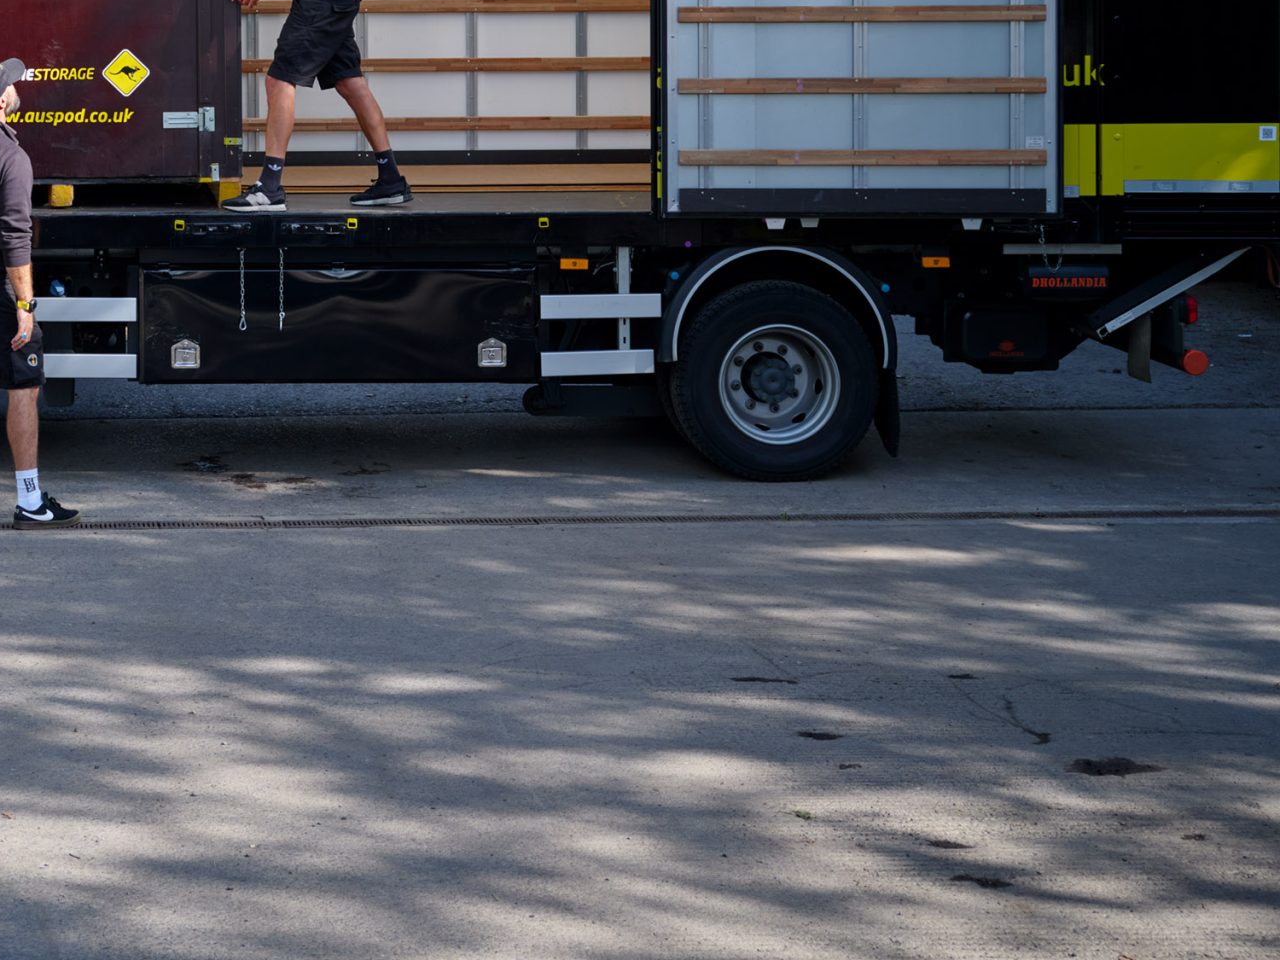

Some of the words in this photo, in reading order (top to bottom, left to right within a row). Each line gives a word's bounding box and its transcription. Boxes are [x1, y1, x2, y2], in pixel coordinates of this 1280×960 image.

[21, 67, 95, 81] ESTORAGE
[6, 107, 135, 126] w.auspod.co.uk
[1031, 277, 1108, 288] DHOLLANDIA
